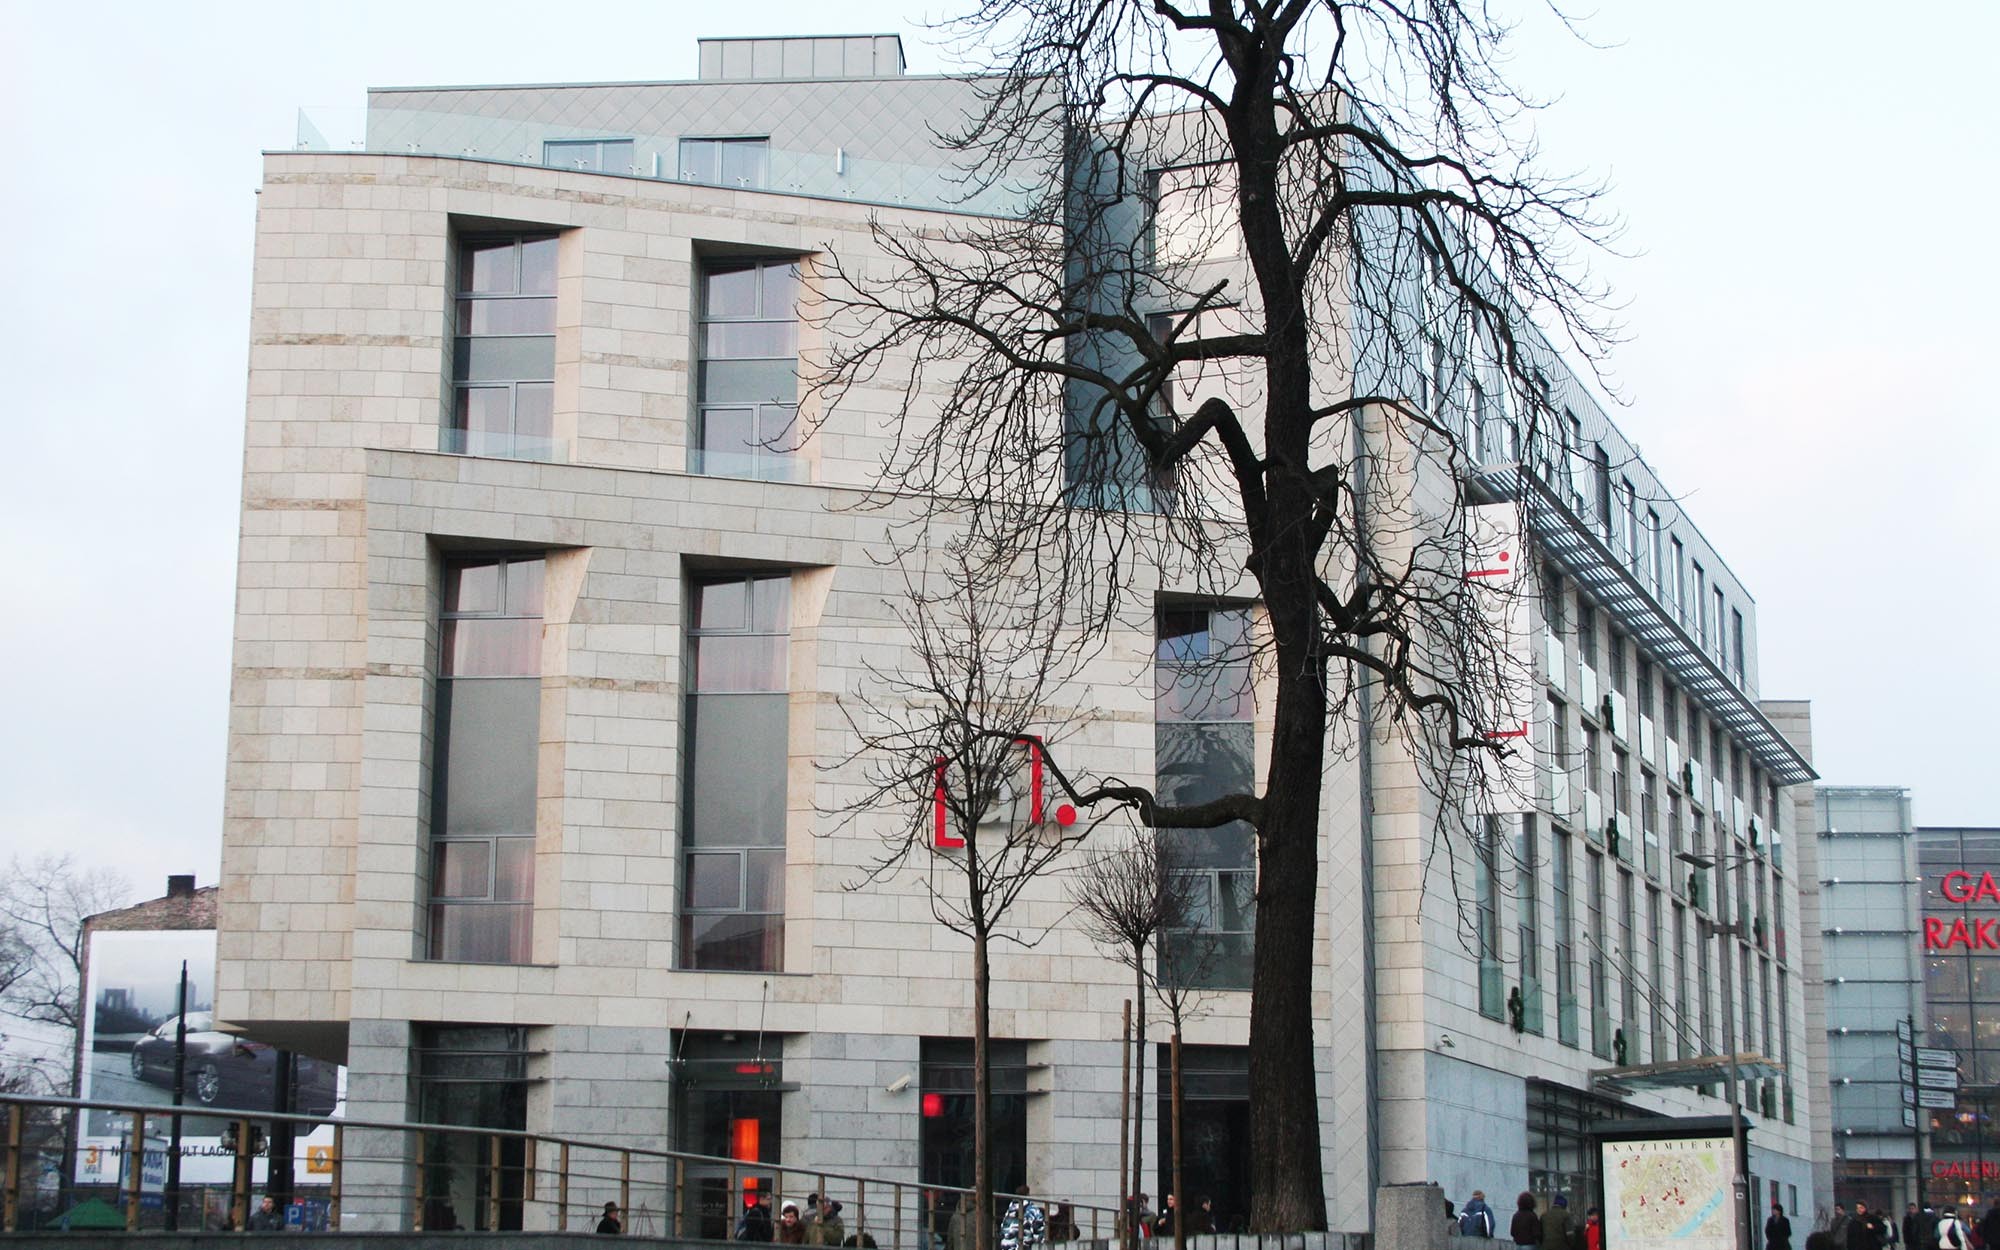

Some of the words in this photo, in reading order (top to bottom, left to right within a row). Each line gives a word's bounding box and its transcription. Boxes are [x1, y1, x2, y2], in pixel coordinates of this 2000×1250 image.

[1925, 916, 2000, 950] RAK
[1612, 1139, 1727, 1153] KAZIMIERZ
[1932, 1160, 2000, 1180] GALERI
[289, 1207, 300, 1222] P
